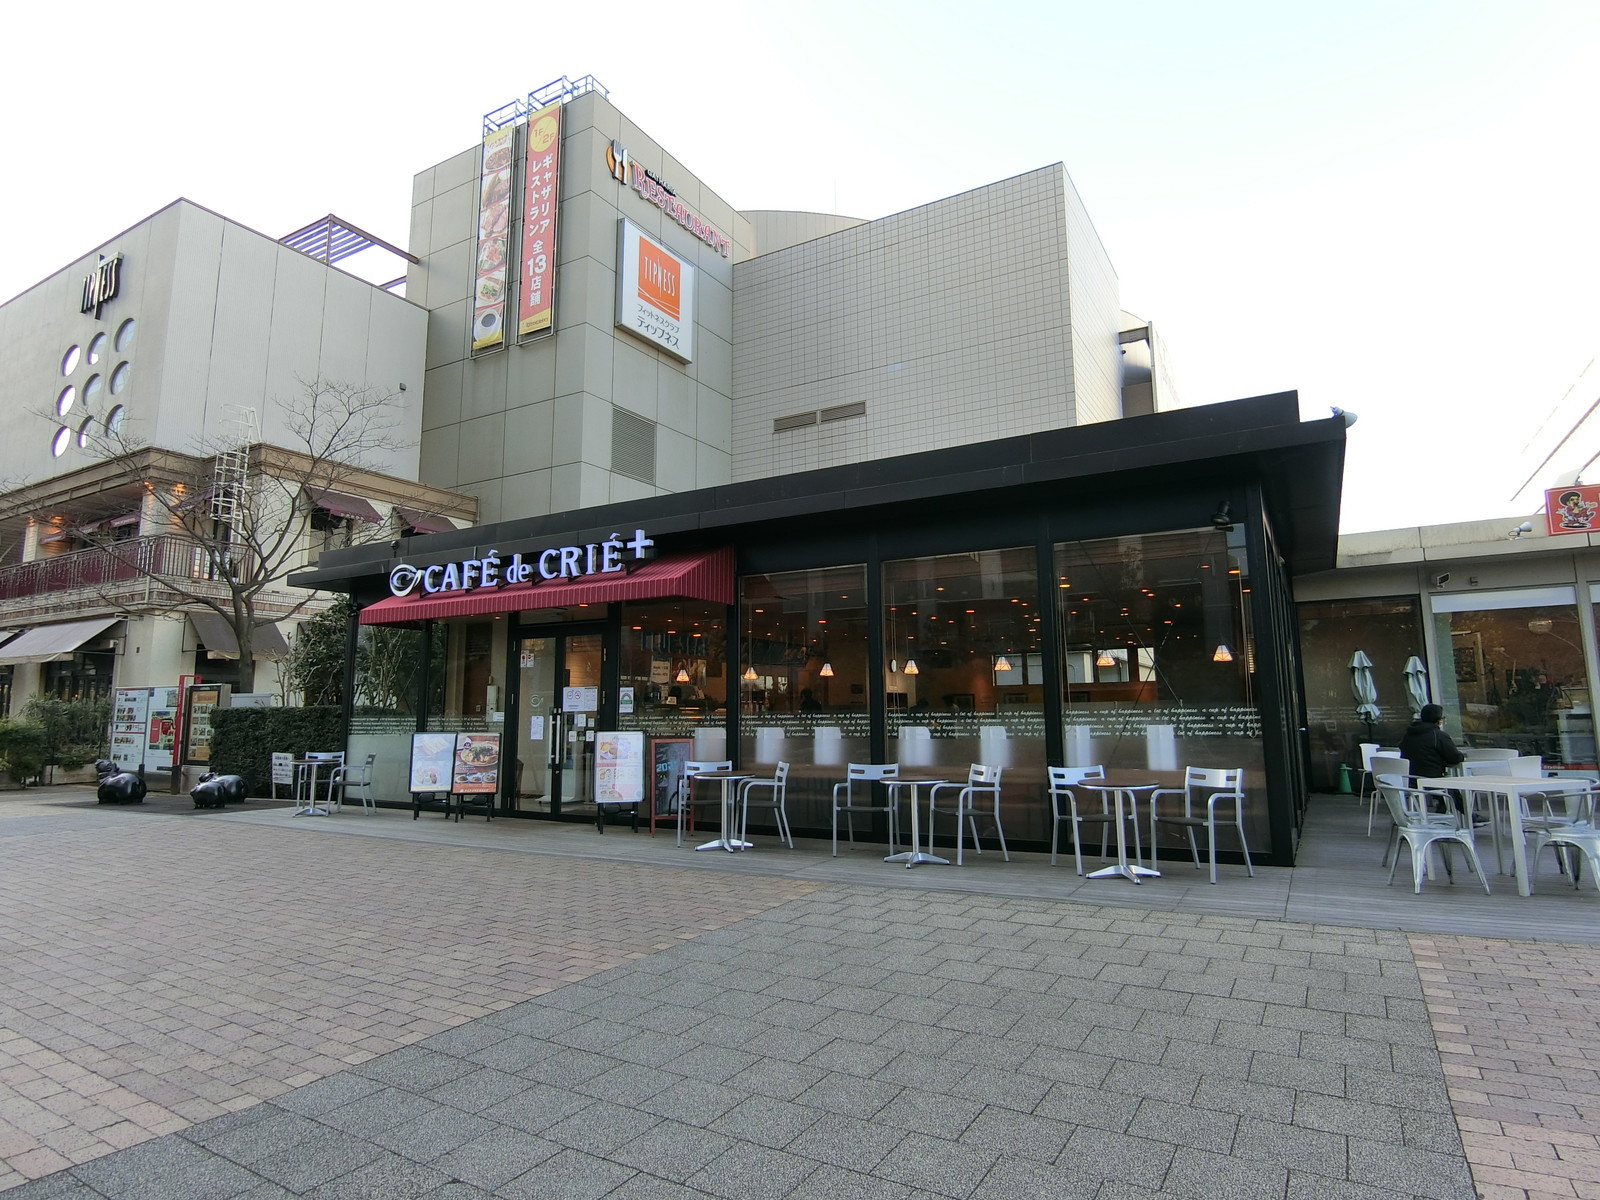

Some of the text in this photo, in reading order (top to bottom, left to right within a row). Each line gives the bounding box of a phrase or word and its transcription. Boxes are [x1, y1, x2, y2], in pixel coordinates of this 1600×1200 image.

[543, 133, 554, 144] 2F
[529, 161, 541, 237] レストラン
[540, 153, 553, 234] ギャザリア
[630, 161, 731, 258] RESTAURANT
[644, 256, 675, 297] TIPNESS
[637, 304, 680, 333] フィットネスクラブ
[637, 315, 680, 350] ティップネス
[506, 554, 532, 584] de
